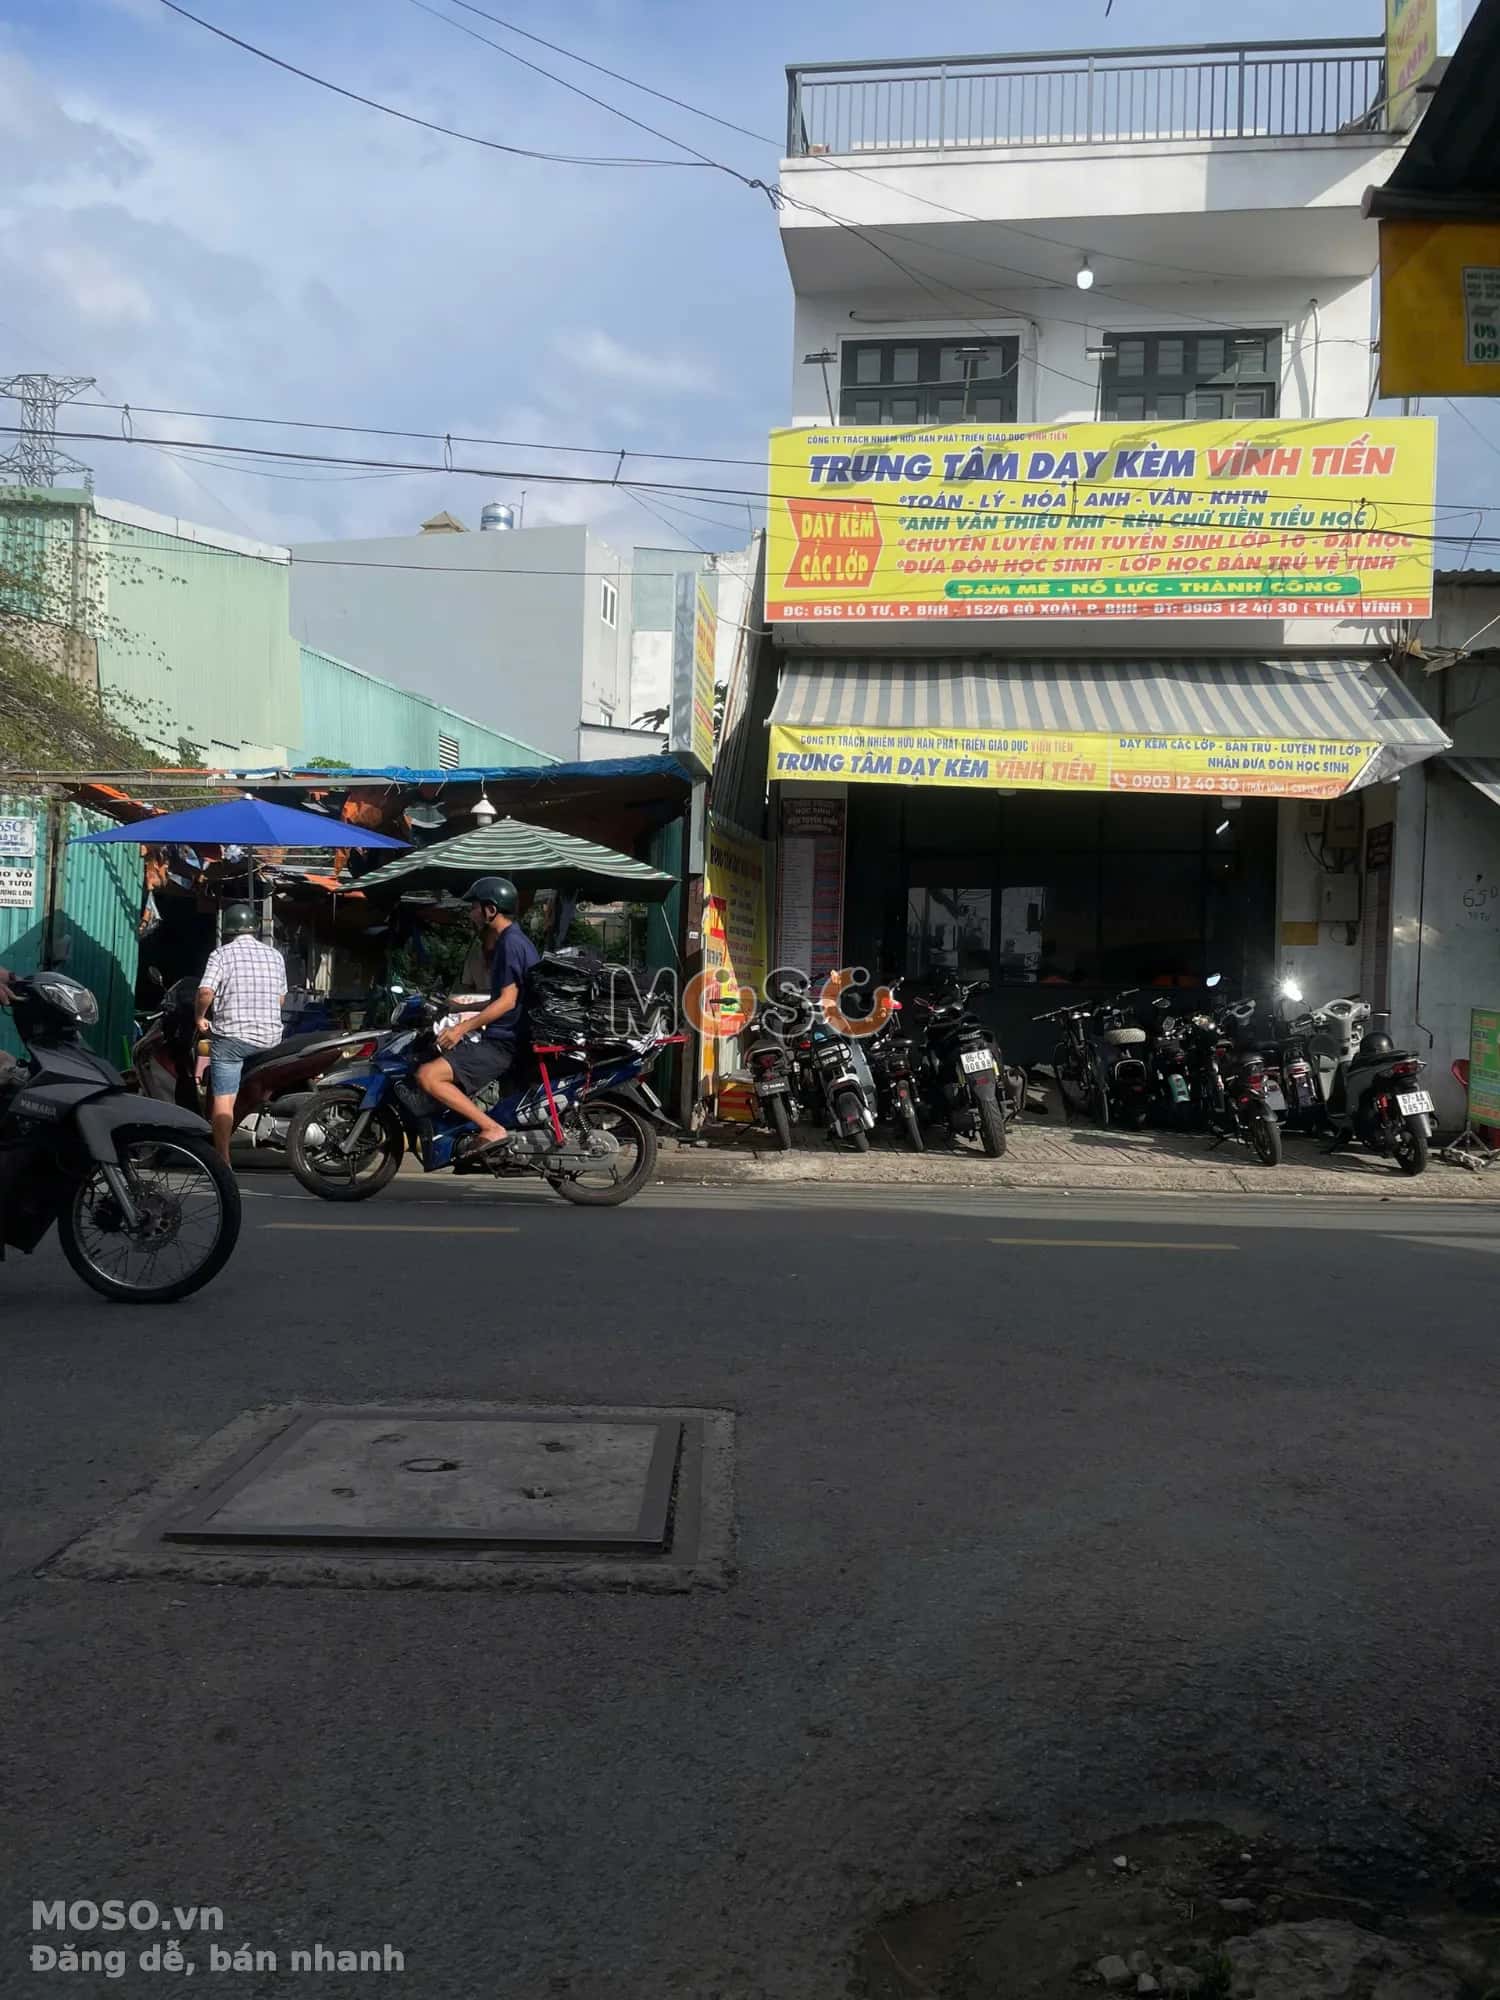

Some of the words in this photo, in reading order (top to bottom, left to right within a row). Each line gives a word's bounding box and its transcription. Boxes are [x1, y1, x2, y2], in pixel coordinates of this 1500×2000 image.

[832, 435, 841, 444] TY
[809, 454, 932, 483] TRUNG
[944, 446, 1019, 481] TÂM
[1027, 451, 1109, 488] DẠY
[1114, 442, 1196, 478] KÈM
[1207, 442, 1302, 476] VĨNH
[1312, 433, 1396, 476] TIẾN
[980, 490, 1005, 508] LÝ
[1022, 489, 1066, 508] HÓA
[1084, 492, 1130, 506] ANH
[1150, 487, 1193, 506] VĂN
[1210, 490, 1268, 505] KHTN
[957, 511, 998, 530] VĂN
[1004, 508, 1061, 530] THIẾU
[1067, 515, 1106, 529] NHI
[1122, 509, 1164, 528] RÈN
[1170, 508, 1215, 526] CHỮ
[1270, 503, 1315, 526] TIỂU
[1320, 511, 1367, 530] HỌC
[991, 533, 1056, 555] LUYỆN
[1063, 536, 1096, 550] THI
[1102, 528, 1168, 550] TUYỂN
[1172, 534, 1223, 550] SINH
[1229, 530, 1271, 548] LỚP
[1280, 534, 1305, 548] 10
[1368, 533, 1412, 552] HỌC
[800, 548, 832, 582] CÁC
[835, 547, 869, 582] LỚP
[1003, 558, 1048, 577] HỌC
[1052, 558, 1102, 572] SINH
[1120, 554, 1161, 571] LỚP
[1166, 556, 1212, 575] HỌC
[1217, 552, 1261, 571] BÁN
[1268, 552, 1308, 570] TRÚ
[1314, 552, 1340, 574] VỆ
[1347, 555, 1396, 570] TINH
[1114, 580, 1159, 596] LỰC
[1179, 580, 1262, 594] THÀNH
[1270, 580, 1343, 593] CÔNG
[900, 605, 912, 616] P.
[965, 604, 1008, 616] 152/6
[1183, 603, 1222, 613] 0903
[1230, 602, 1247, 613] 12
[1253, 602, 1272, 613] 40
[1278, 602, 1297, 613] 30
[826, 735, 835, 745] TY
[1319, 745, 1336, 756] THI
[777, 752, 845, 771] TRUNG
[851, 751, 893, 774] TÂM
[898, 756, 940, 782] DẠY
[944, 754, 989, 778] KÈM
[996, 757, 1044, 780] VĨNH
[1052, 753, 1097, 781] TIẾN
[1297, 761, 1319, 775] HỌC
[1322, 761, 1349, 773] SINH
[1132, 775, 1170, 788] 0903
[1176, 775, 1191, 790] 12
[1196, 776, 1215, 790] 40
[1220, 777, 1239, 792] 30
